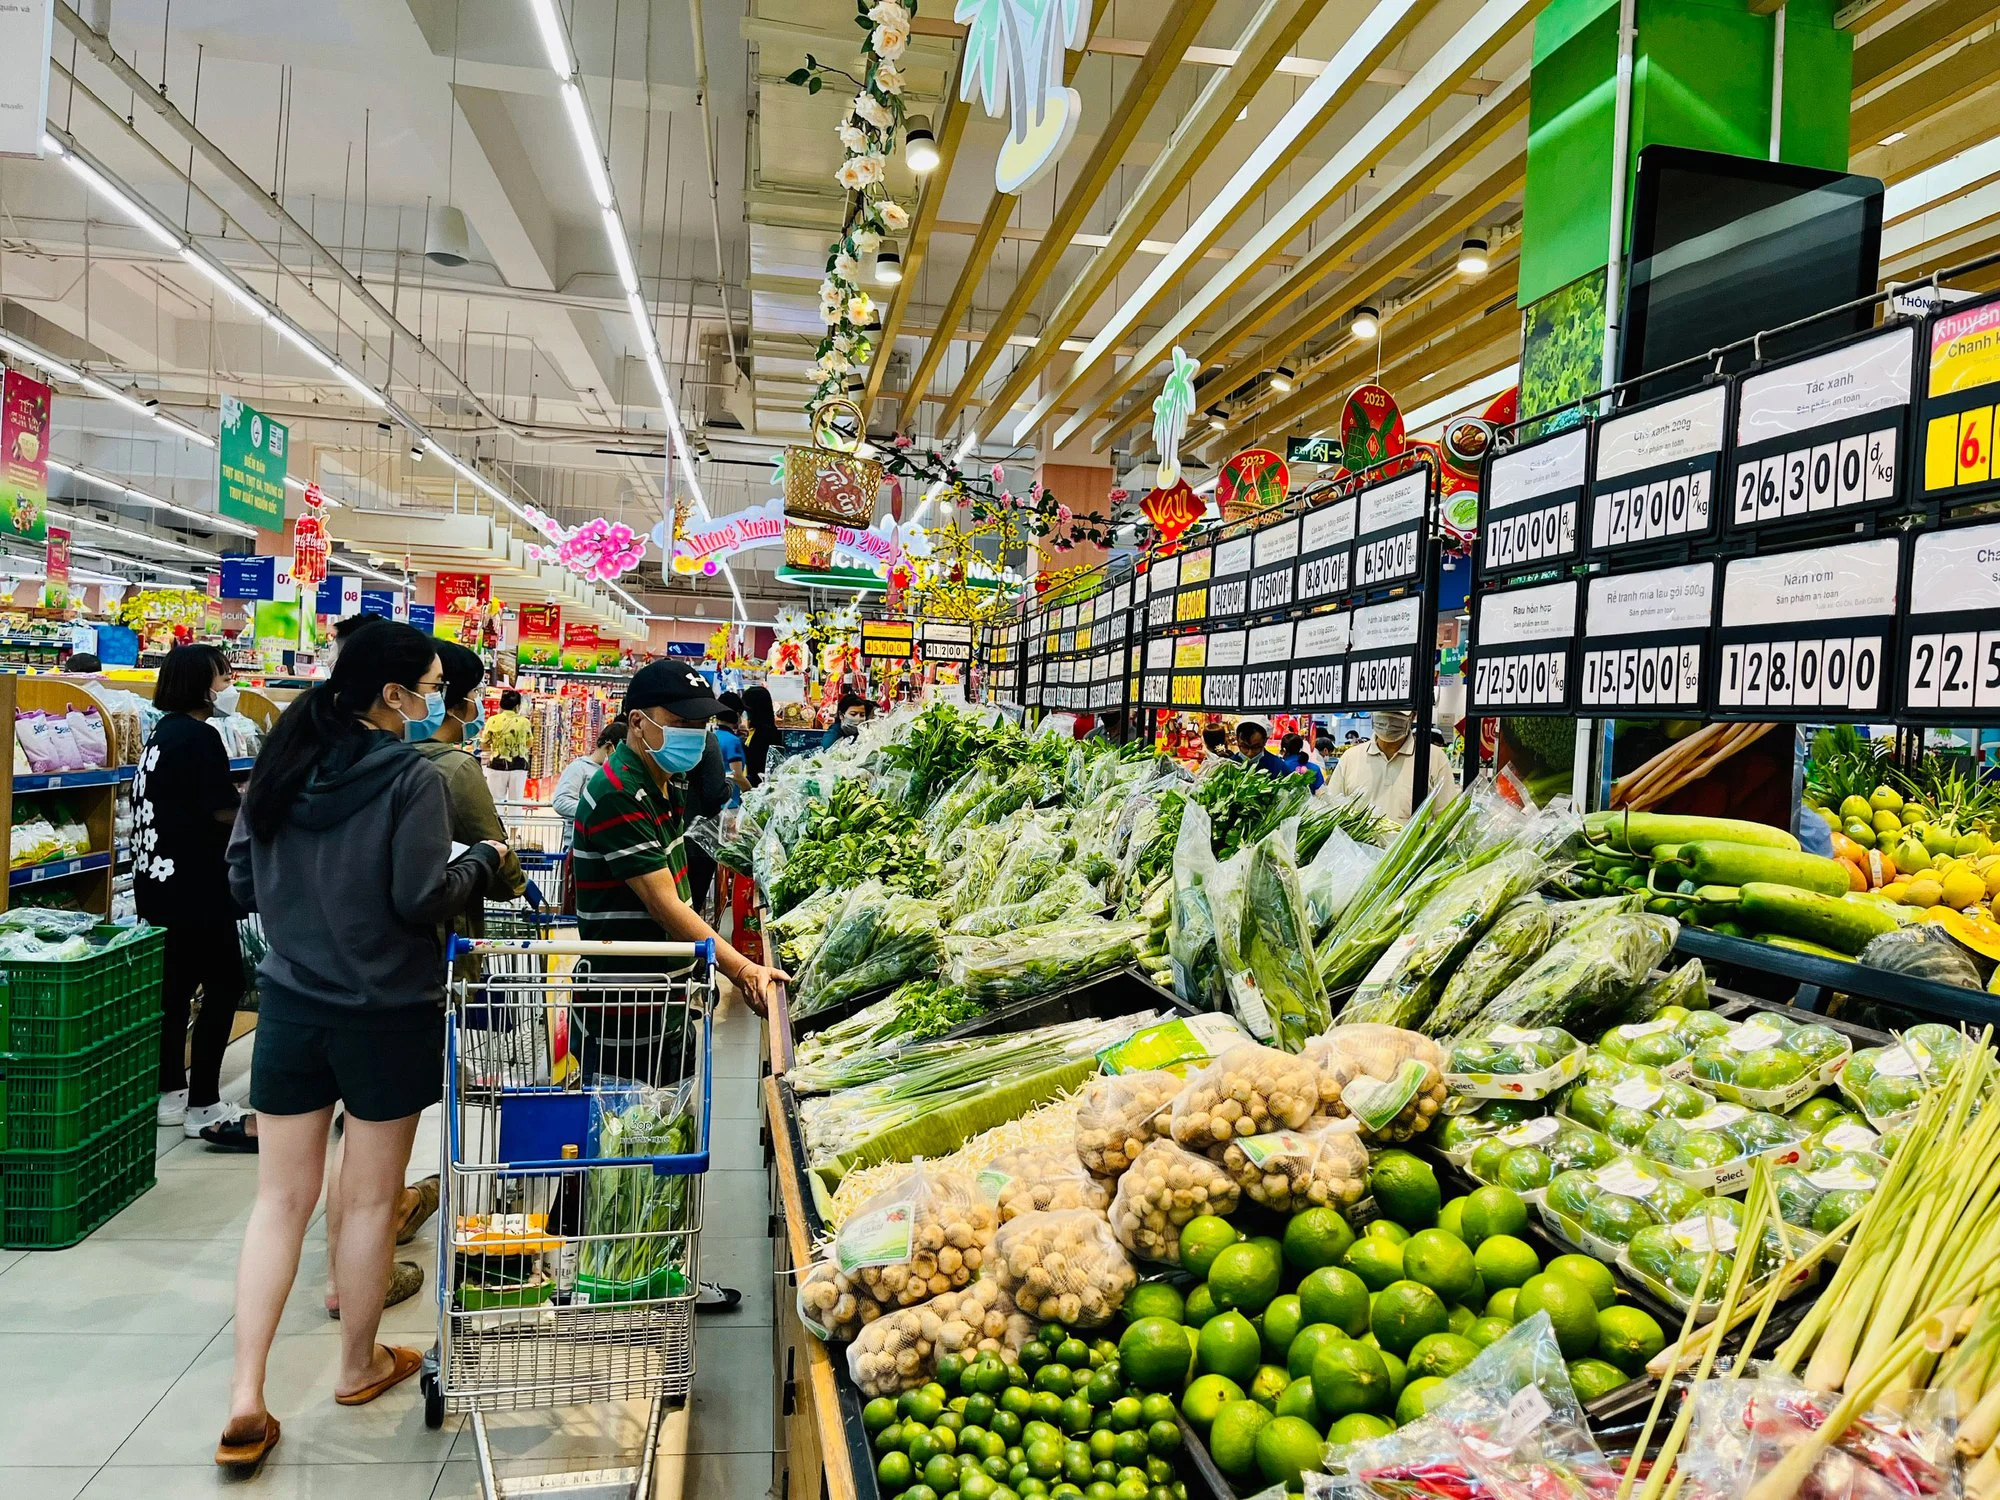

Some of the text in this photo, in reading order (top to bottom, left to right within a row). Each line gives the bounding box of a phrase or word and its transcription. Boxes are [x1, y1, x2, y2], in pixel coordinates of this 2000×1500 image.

[1948, 335, 1992, 358] Chanh
[1828, 372, 1854, 392] xanh
[1363, 391, 1386, 408] 2023
[1671, 419, 1692, 434] 200g
[1240, 454, 1266, 467] 2023
[1740, 441, 1893, 512] 26.300 đ/kg
[1612, 485, 1686, 535] 7.900
[685, 523, 739, 559] Mừng
[736, 516, 782, 541] Xuân
[1490, 513, 1556, 557] 17.000
[1364, 543, 1403, 576] 6.500
[277, 573, 291, 585] 07
[1306, 559, 1338, 591] 8.800
[344, 591, 358, 602] 08
[1257, 574, 1284, 601] 7.500
[1684, 584, 1705, 599] 500g
[221, 611, 247, 621] scuits
[1513, 605, 1525, 615] Rau
[1359, 664, 1398, 693] 6.800
[1475, 661, 1546, 695] 72.500
[1588, 655, 1673, 694] 15.500
[1729, 648, 1875, 692] 128.000
[1251, 675, 1278, 701] 7.500
[1300, 671, 1332, 698] 5.500
[1450, 1082, 1476, 1091] Select
[1785, 1084, 1809, 1101] Select
[1715, 1168, 1745, 1184] Select
